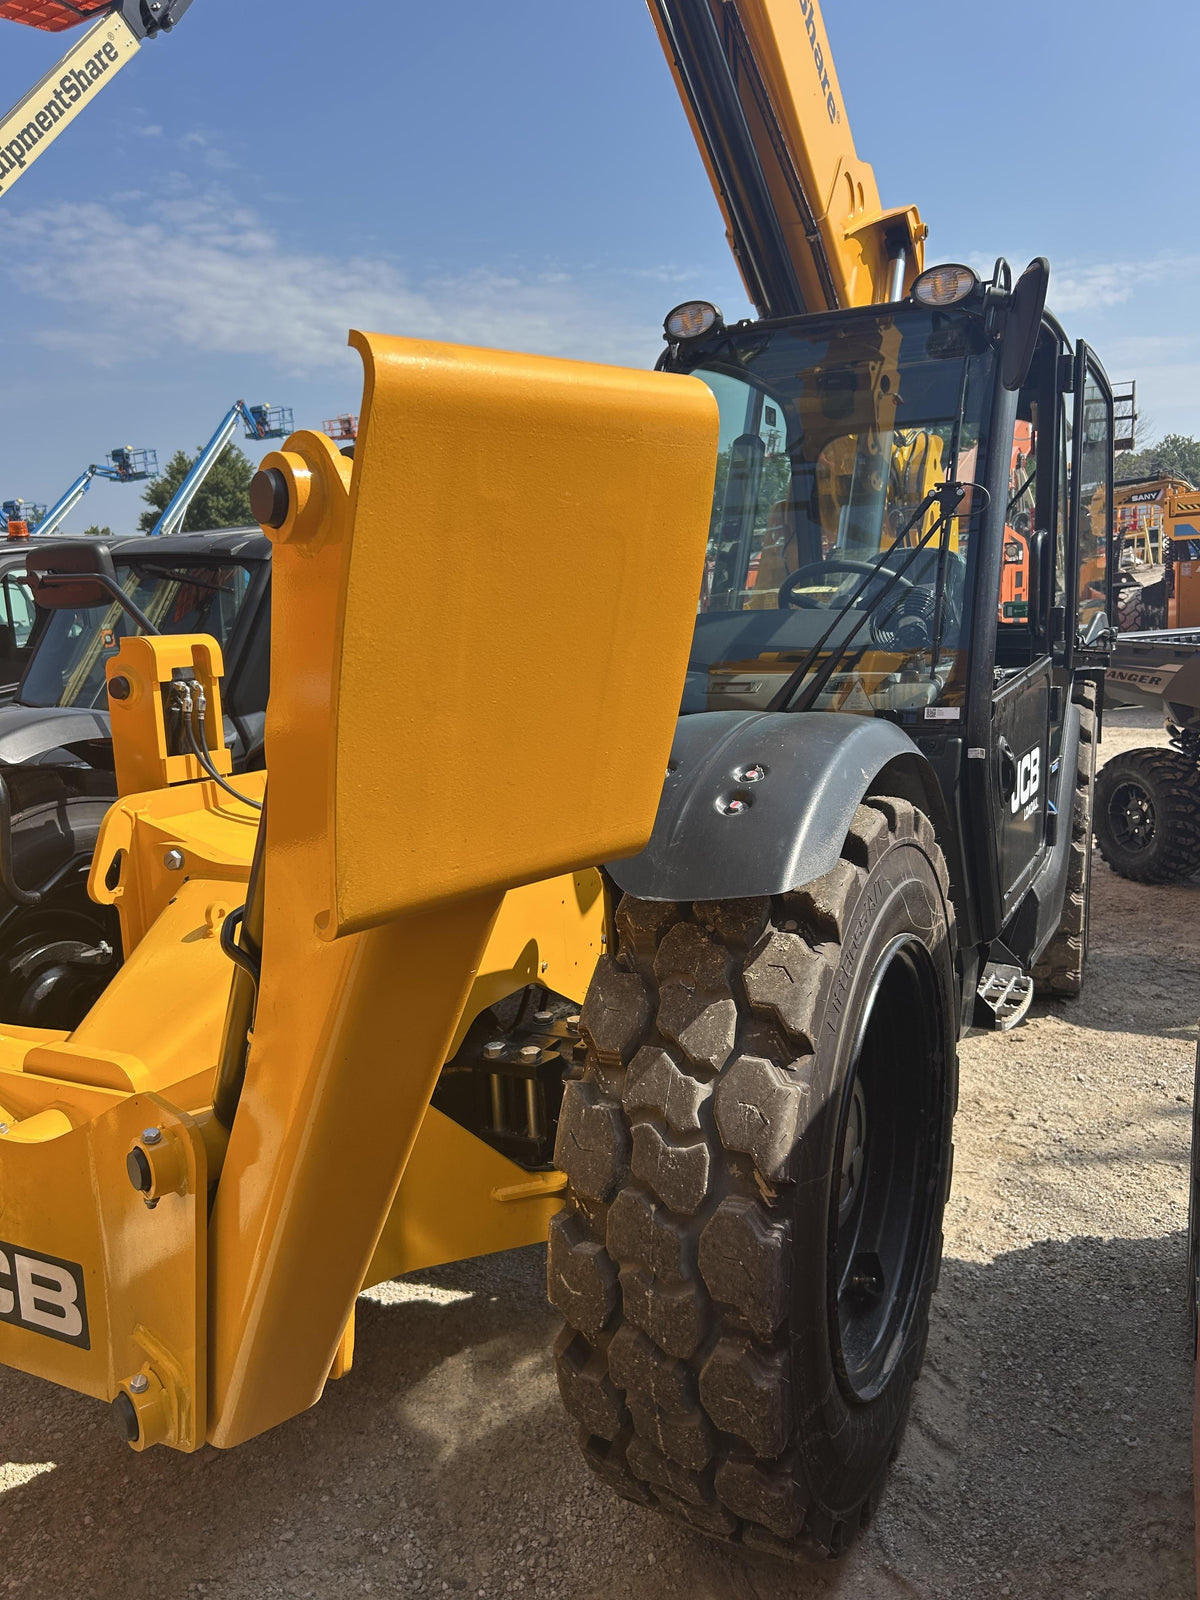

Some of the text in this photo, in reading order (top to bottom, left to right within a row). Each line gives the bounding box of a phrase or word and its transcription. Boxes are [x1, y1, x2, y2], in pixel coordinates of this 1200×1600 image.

[0, 41, 118, 191] uipmentShare
[1131, 492, 1157, 501] SANY
[1106, 670, 1162, 686] ANGER
[1011, 746, 1040, 814] JCB
[0, 1250, 83, 1337] B
